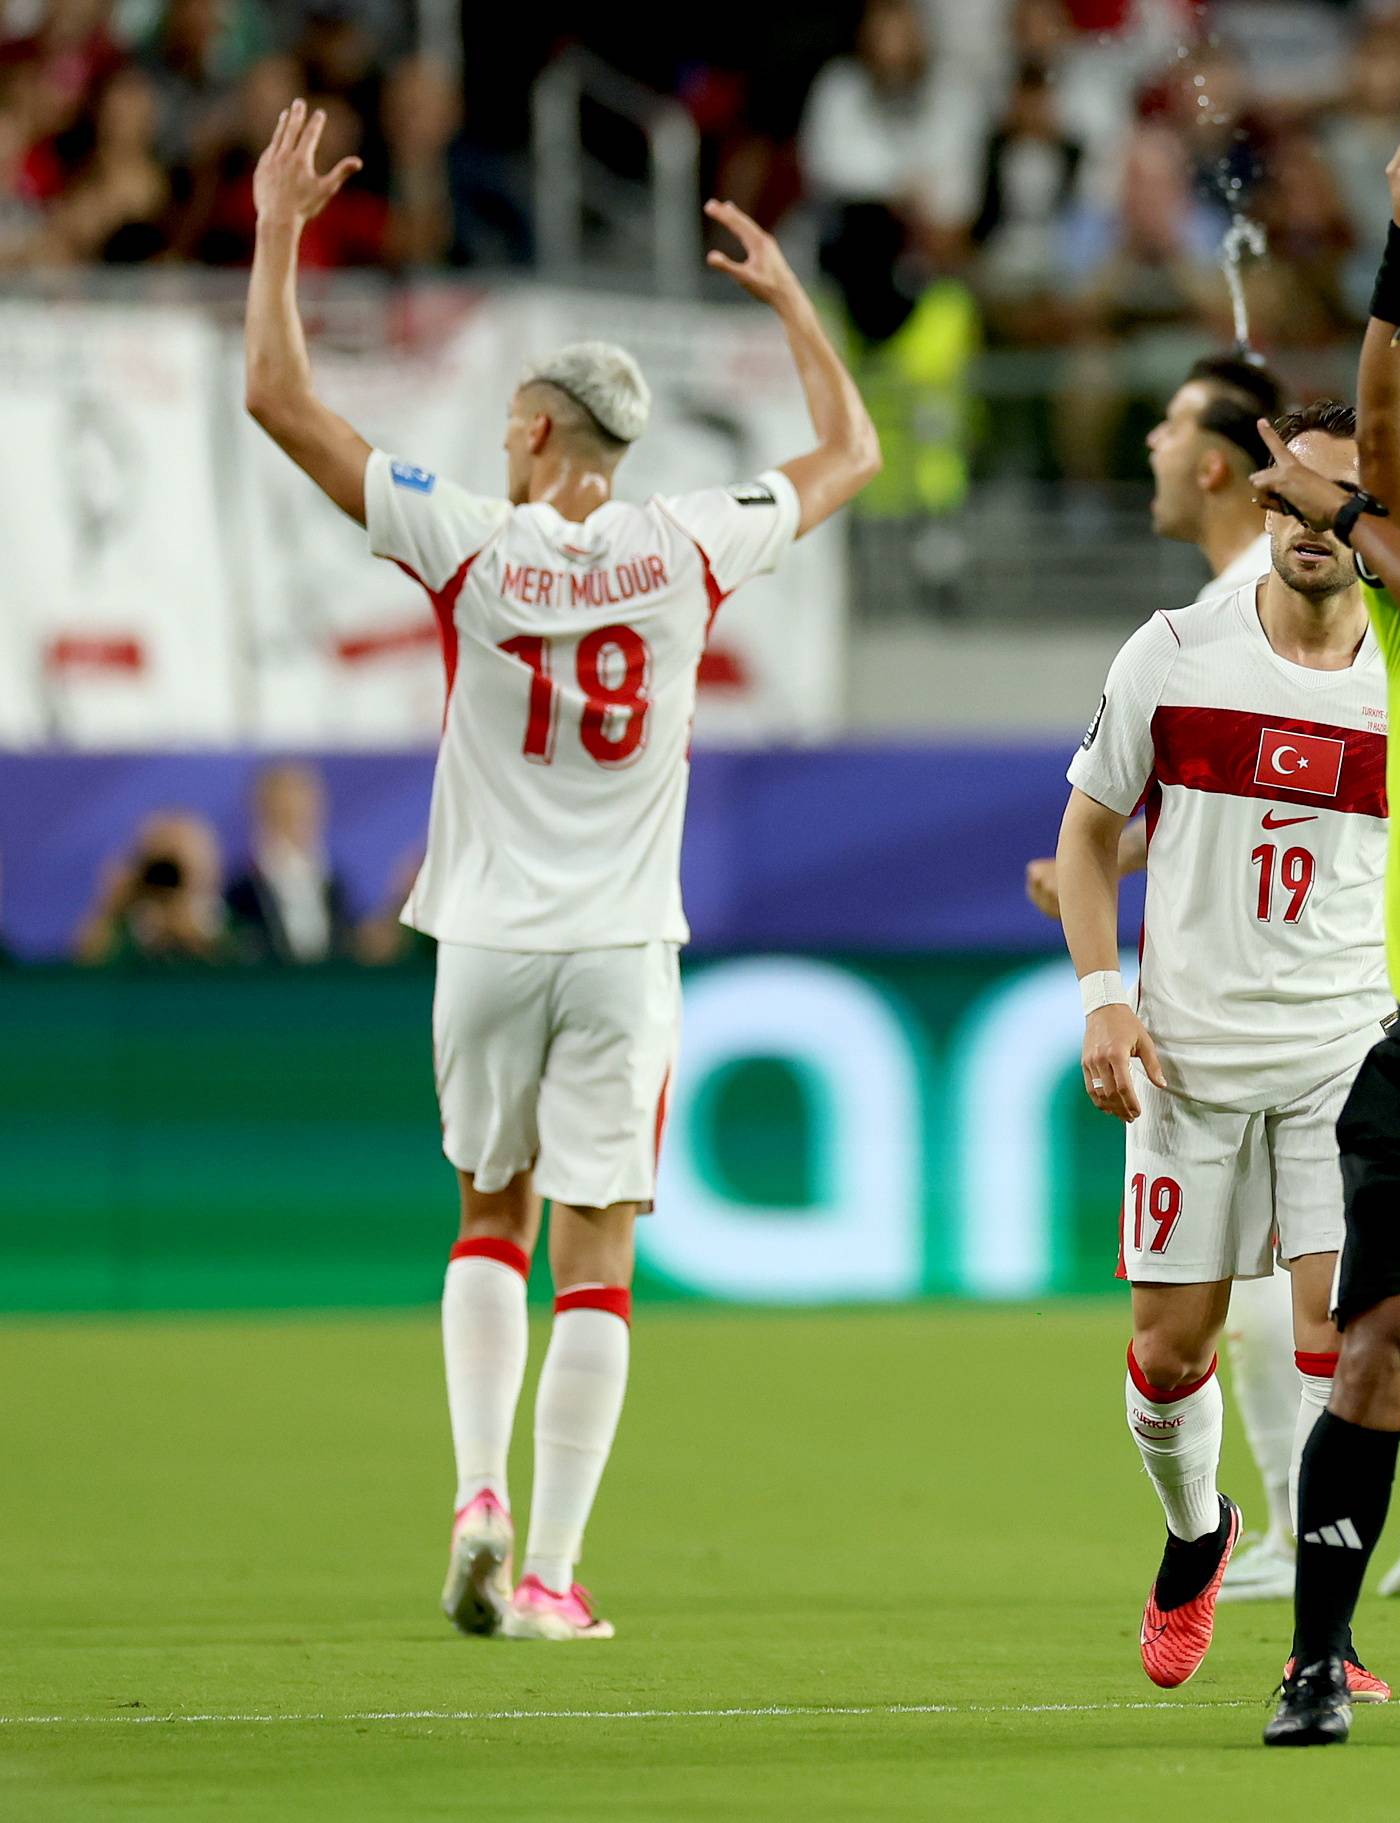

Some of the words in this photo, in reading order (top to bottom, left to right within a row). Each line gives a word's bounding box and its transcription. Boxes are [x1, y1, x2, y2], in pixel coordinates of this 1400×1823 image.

[497, 624, 655, 772] 18
[1251, 843, 1316, 925] 19
[1131, 1172, 1183, 1255] 19
